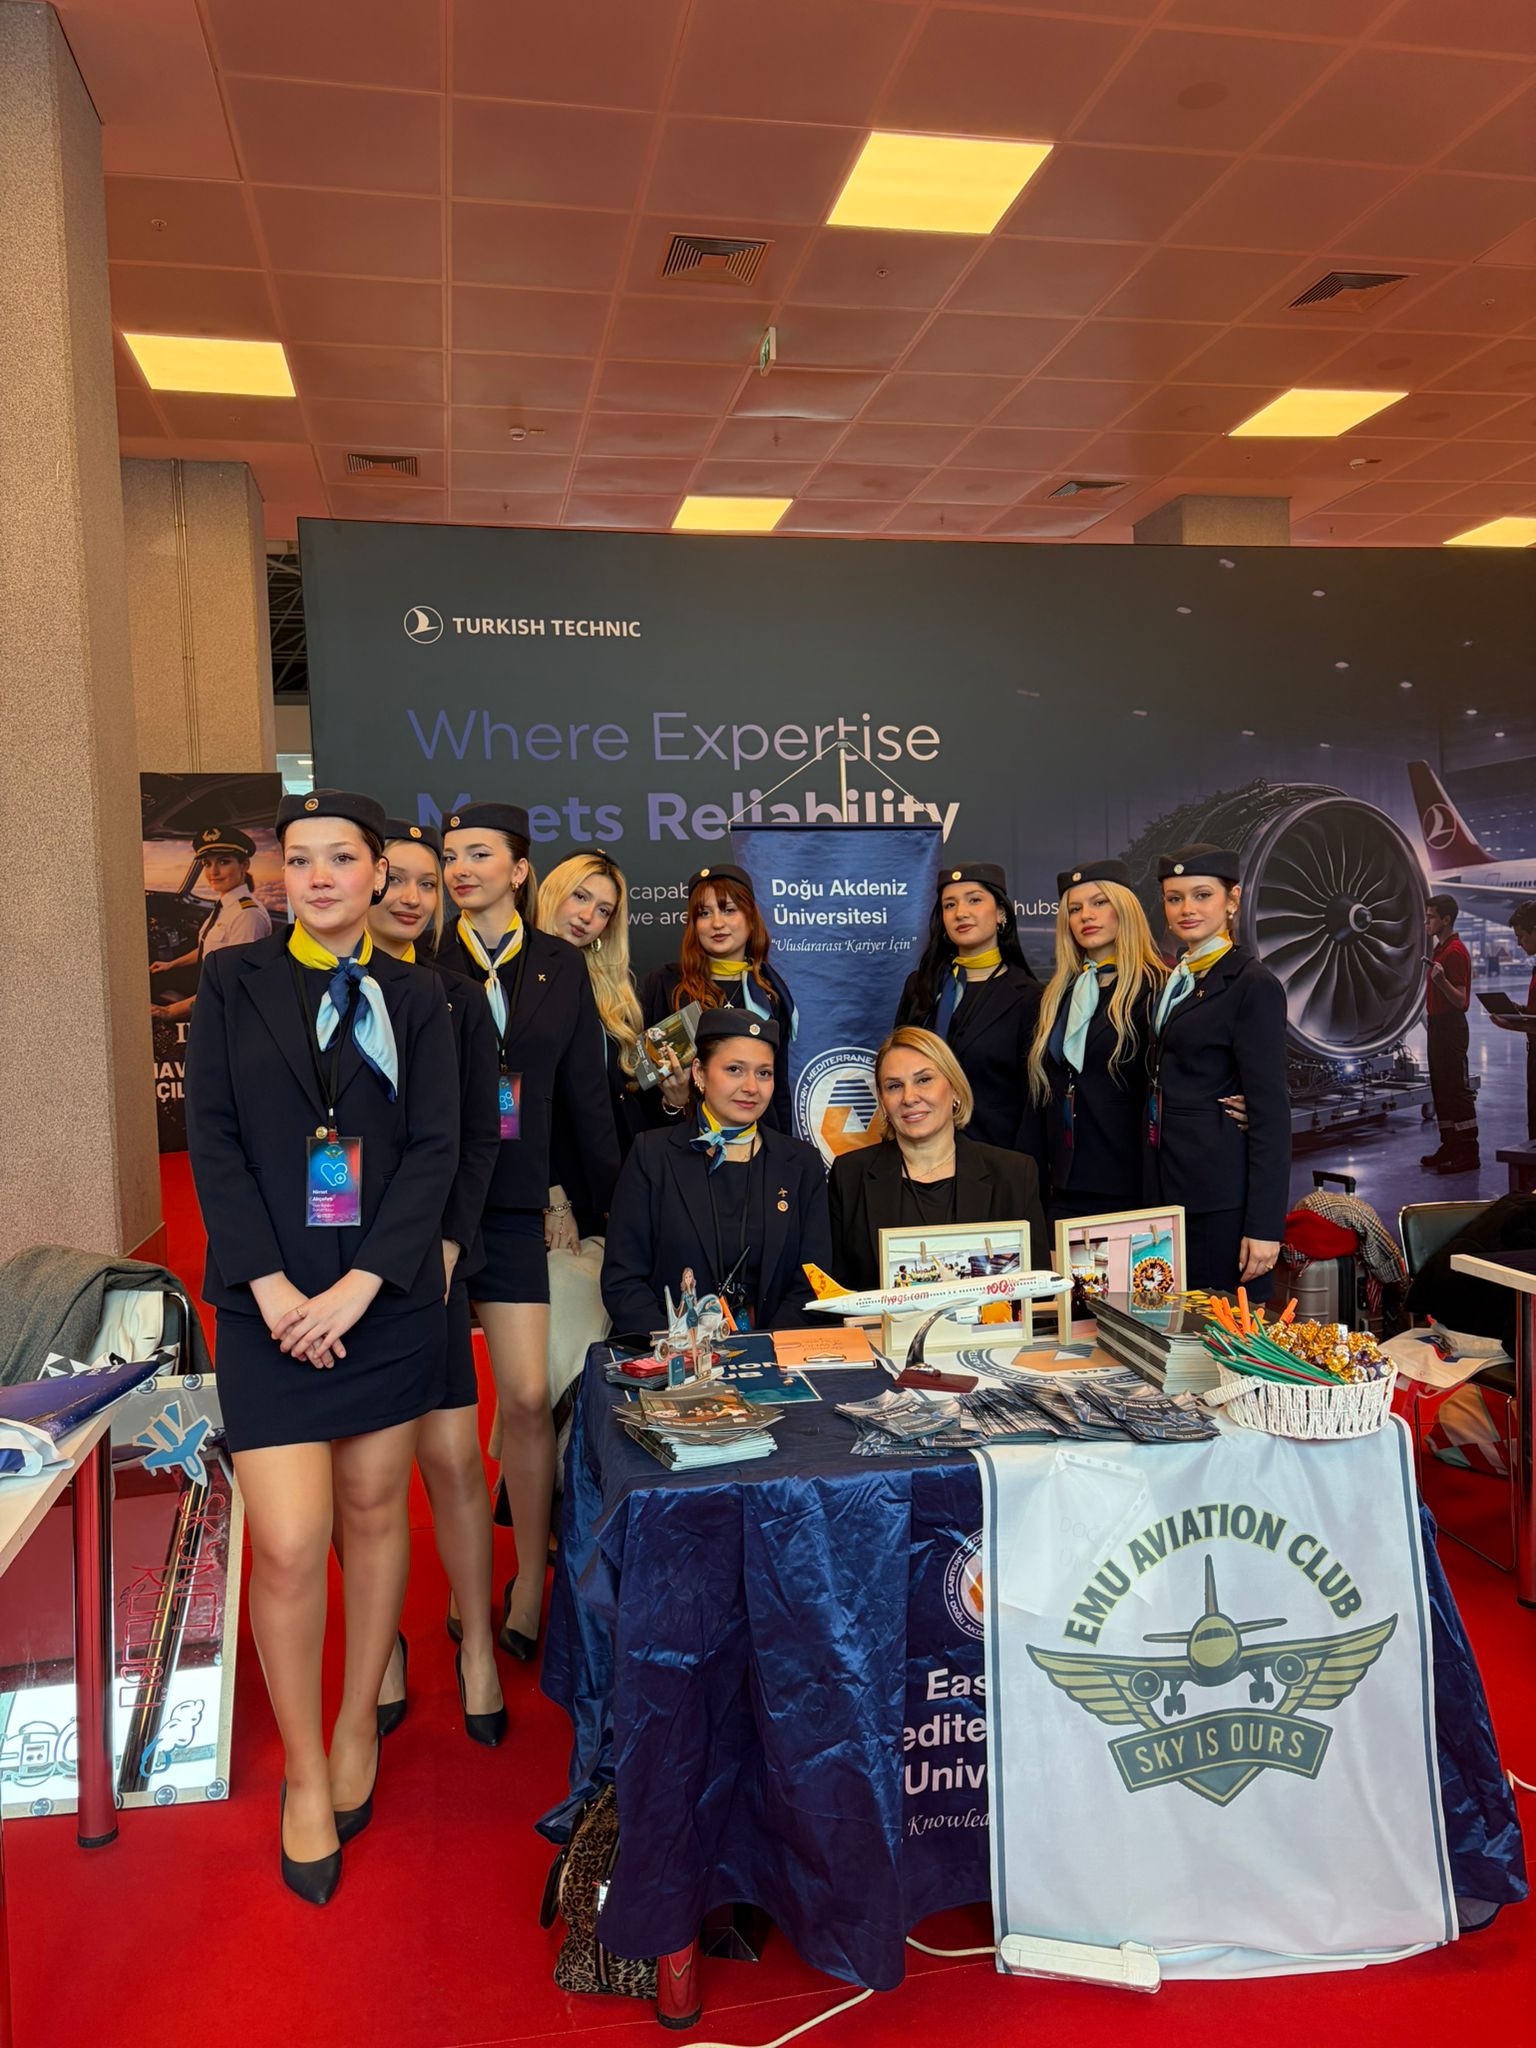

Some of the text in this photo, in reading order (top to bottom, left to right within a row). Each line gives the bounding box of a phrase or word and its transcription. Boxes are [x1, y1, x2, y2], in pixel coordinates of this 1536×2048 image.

[452, 617, 641, 637] TURKISH TECHNIC
[407, 709, 941, 771] Where Expertise
[417, 793, 624, 842] Mets
[771, 879, 908, 900] Doğu Akdeniz
[627, 911, 654, 925] we
[773, 903, 888, 926] Üniversitesi
[1014, 899, 1060, 916] hubs
[1063, 1502, 1363, 1648] EMU AVIATION CLUB
[903, 1713, 987, 1751] edite
[1135, 1722, 1306, 1774] SKY IS OURS
